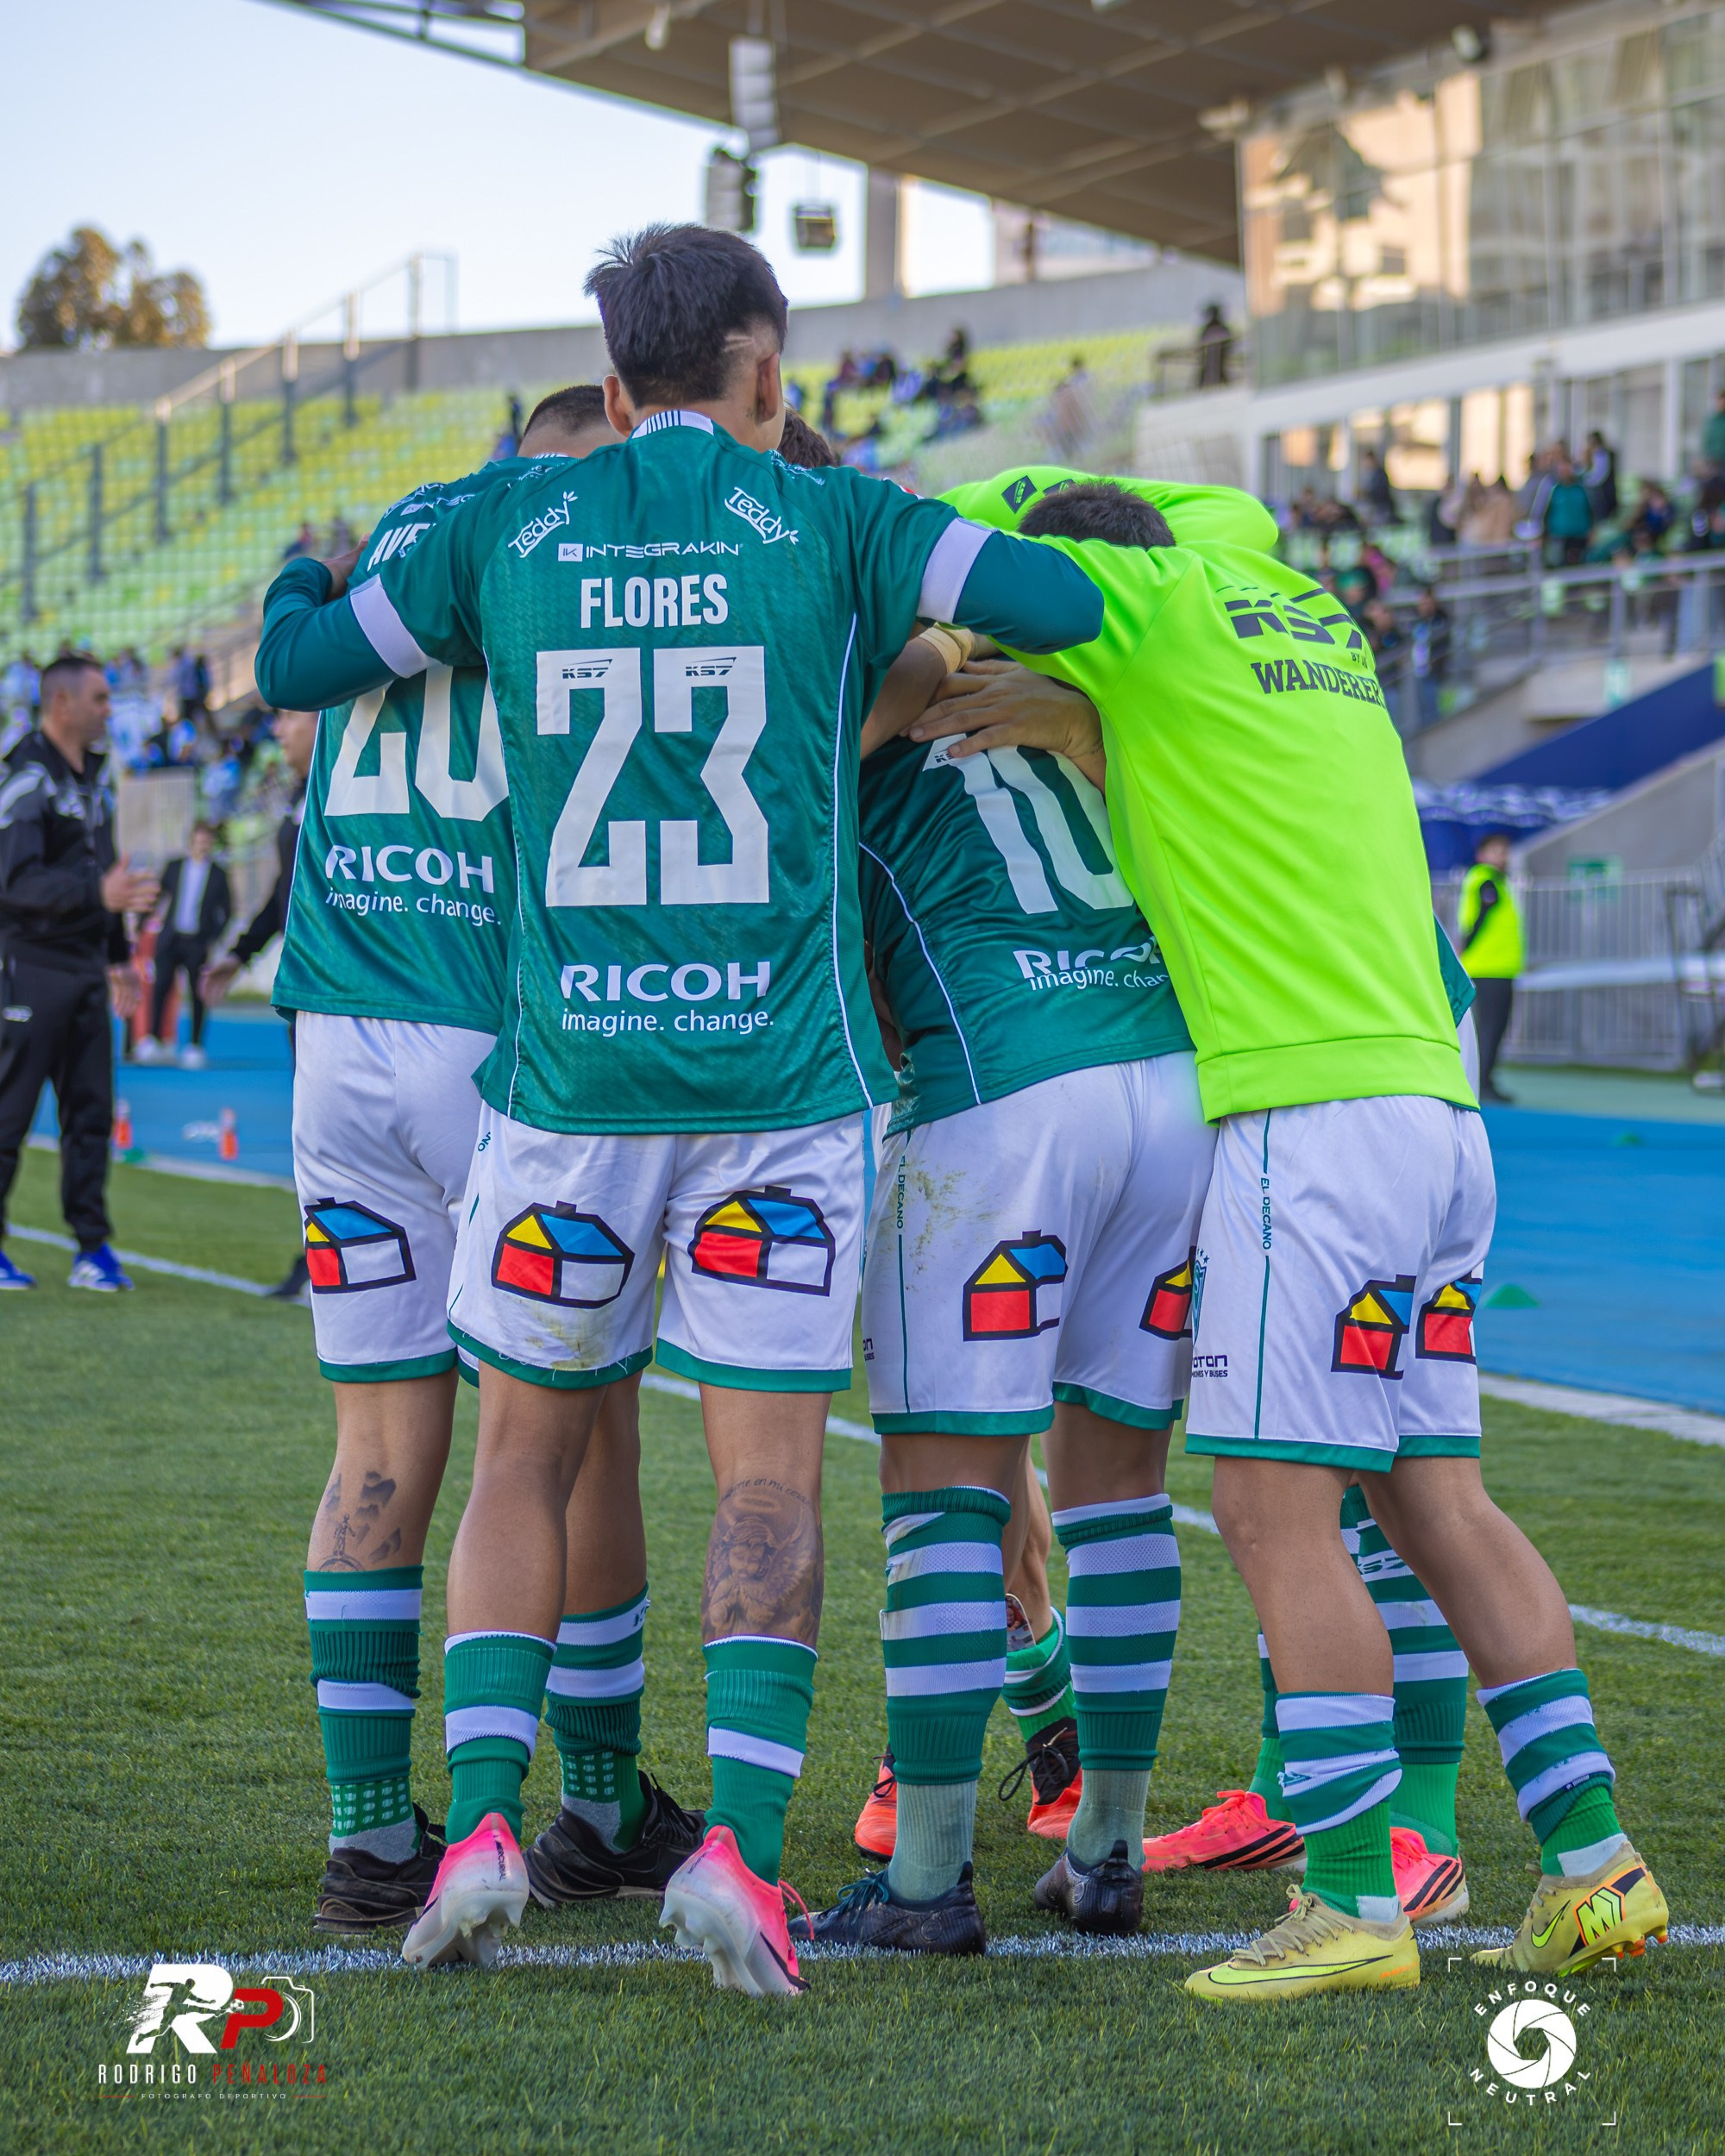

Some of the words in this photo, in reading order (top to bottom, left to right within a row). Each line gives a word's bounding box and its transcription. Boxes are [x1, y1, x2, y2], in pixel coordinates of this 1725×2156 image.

[507, 498, 573, 558] Teddy
[724, 486, 793, 545] Teddy
[586, 542, 739, 559] INTEGRAKIN
[580, 573, 729, 630] FLORES
[1224, 599, 1362, 650] KS7
[562, 665, 610, 680] KS7
[686, 664, 734, 677] KS7
[1251, 659, 1385, 710] WANDERER
[536, 646, 769, 908] 23
[922, 733, 1134, 915] 10
[325, 844, 494, 893] RICOH
[325, 887, 410, 916] imagine.
[416, 893, 502, 927] change.
[560, 962, 771, 1002] RICOH
[1029, 966, 1119, 990] imagine.
[561, 1008, 665, 1037] imagine.
[674, 1007, 775, 1035] change.
[897, 1175, 906, 1229] DECANO
[1261, 1177, 1270, 1194] EL
[1262, 1196, 1272, 1250] DECANO
[1358, 1556, 1408, 1576] S7
